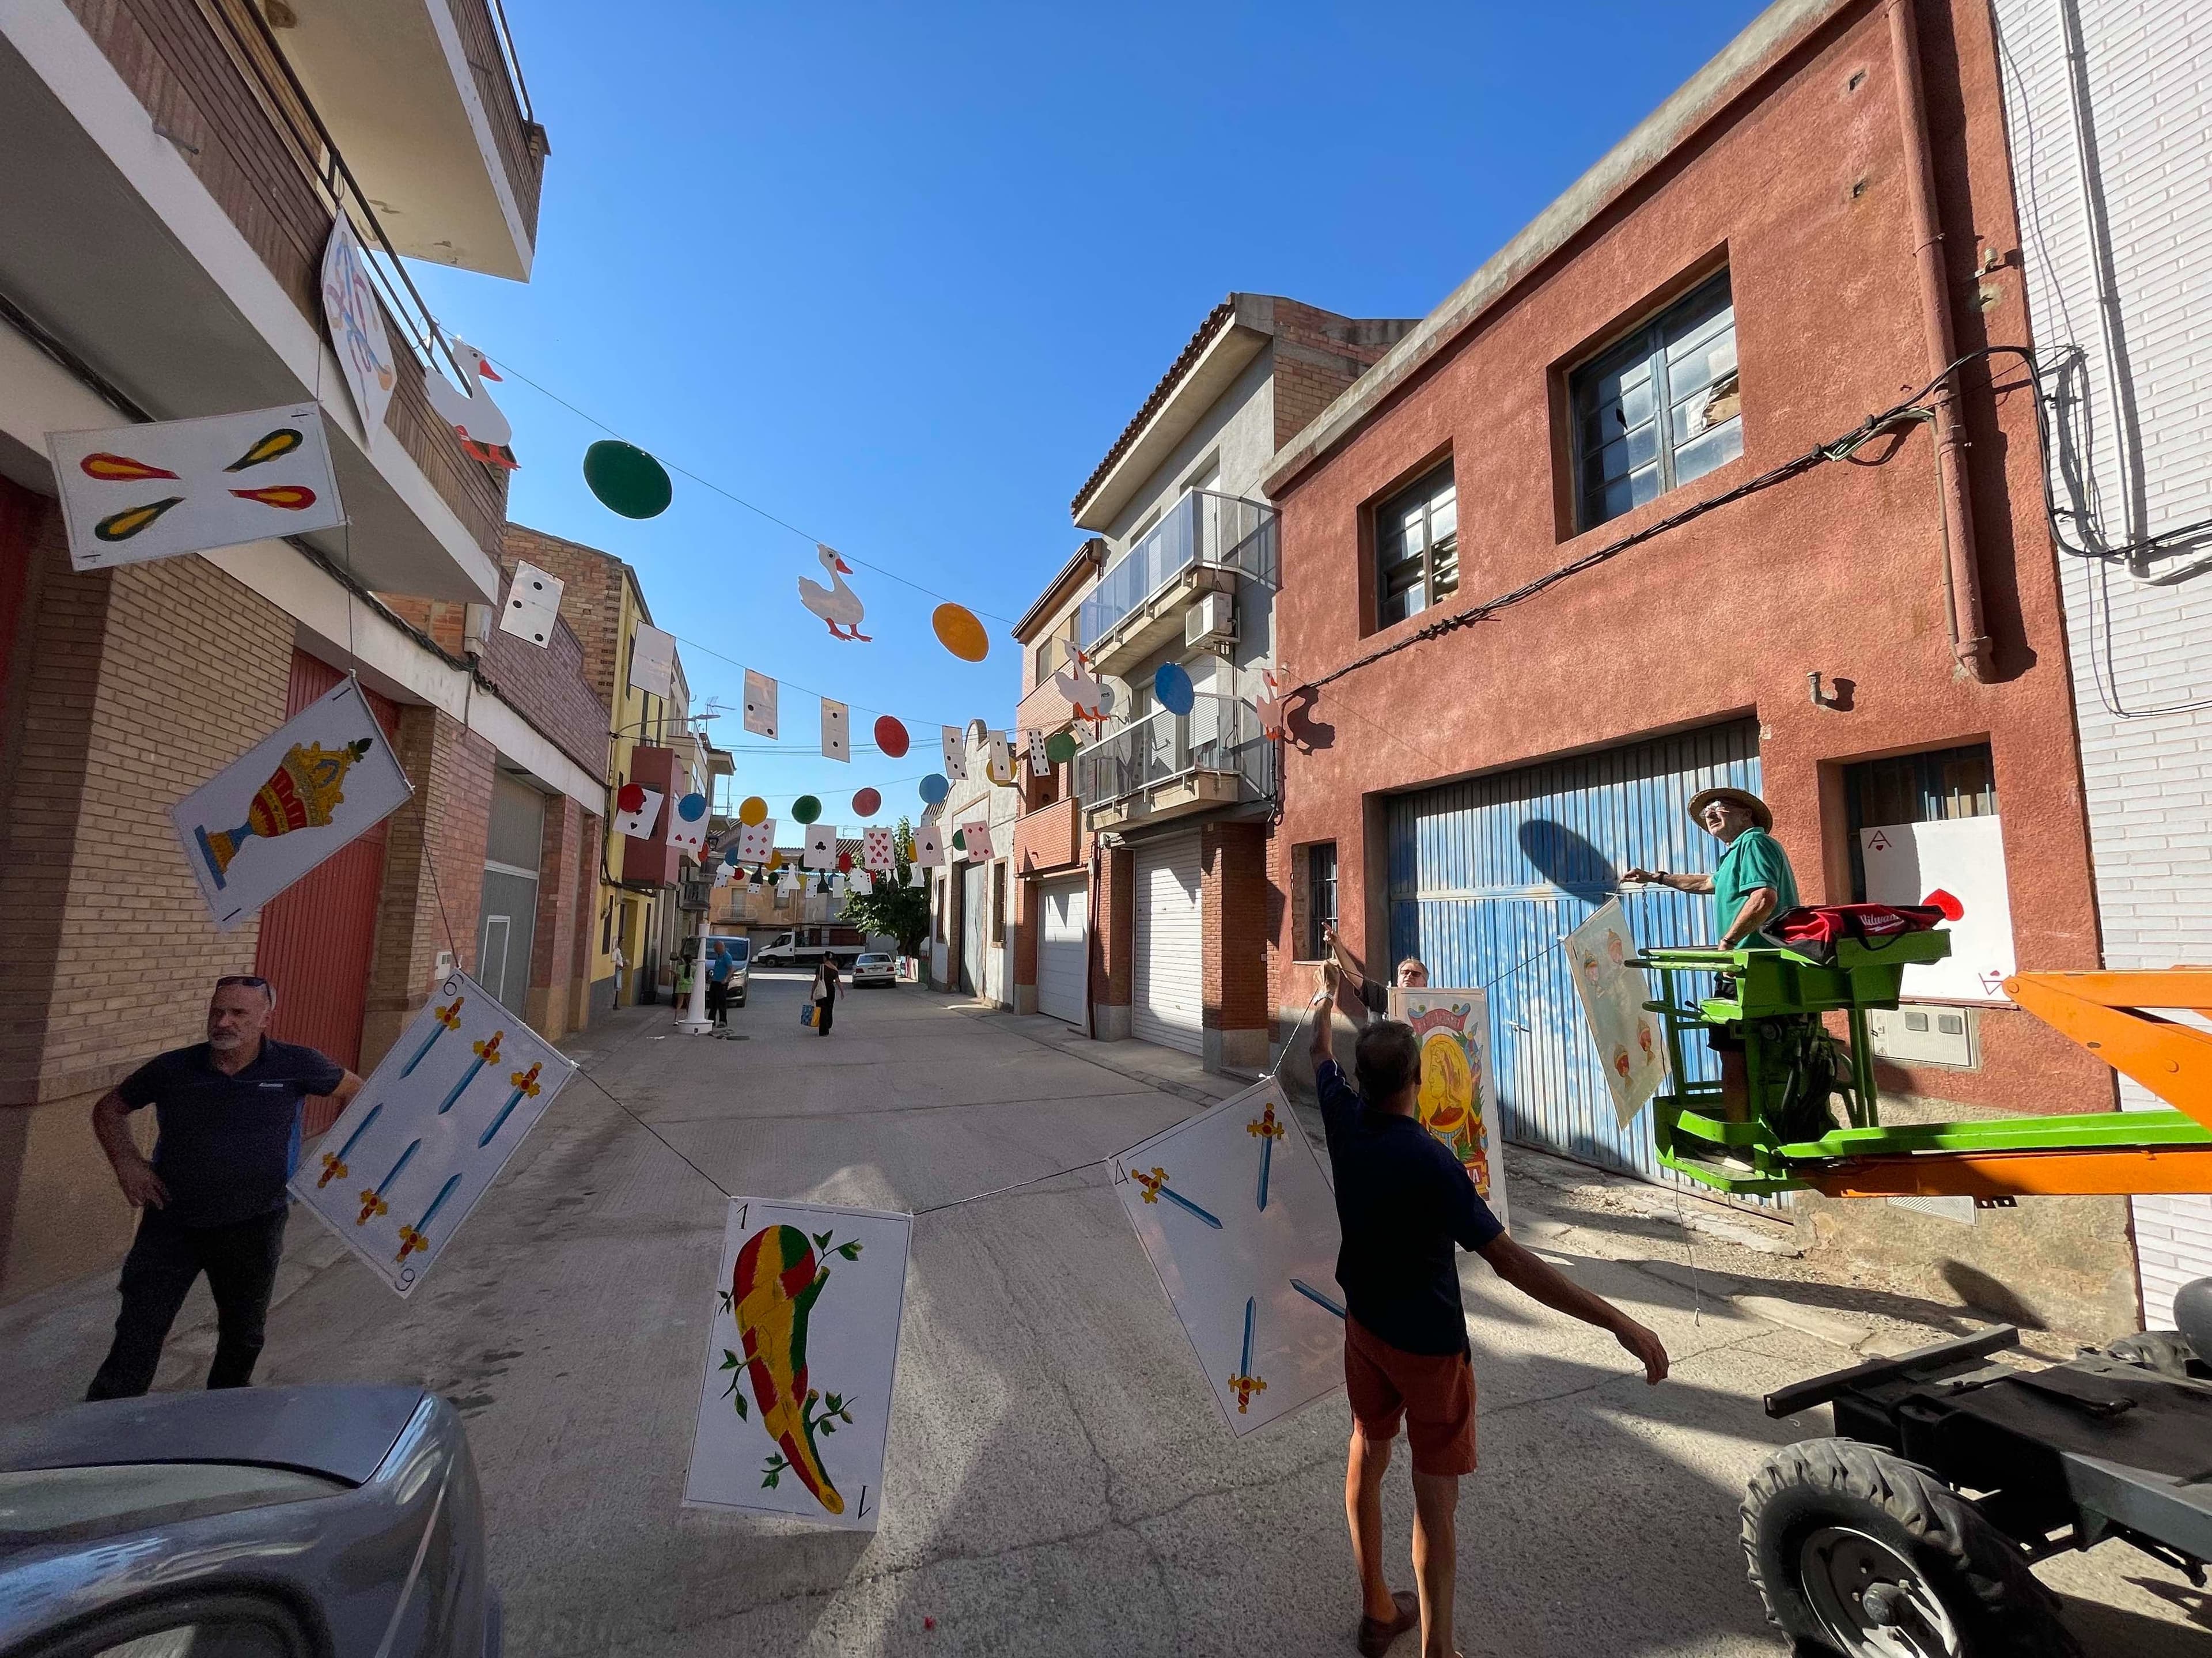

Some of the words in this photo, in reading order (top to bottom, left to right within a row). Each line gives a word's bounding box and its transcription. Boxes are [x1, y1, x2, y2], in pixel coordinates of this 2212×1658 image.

[1868, 830, 1892, 849] A
[444, 973, 464, 997] 6
[1115, 1159, 1129, 1186] 4
[737, 1203, 748, 1230] 1
[857, 1485, 872, 1520] 1
